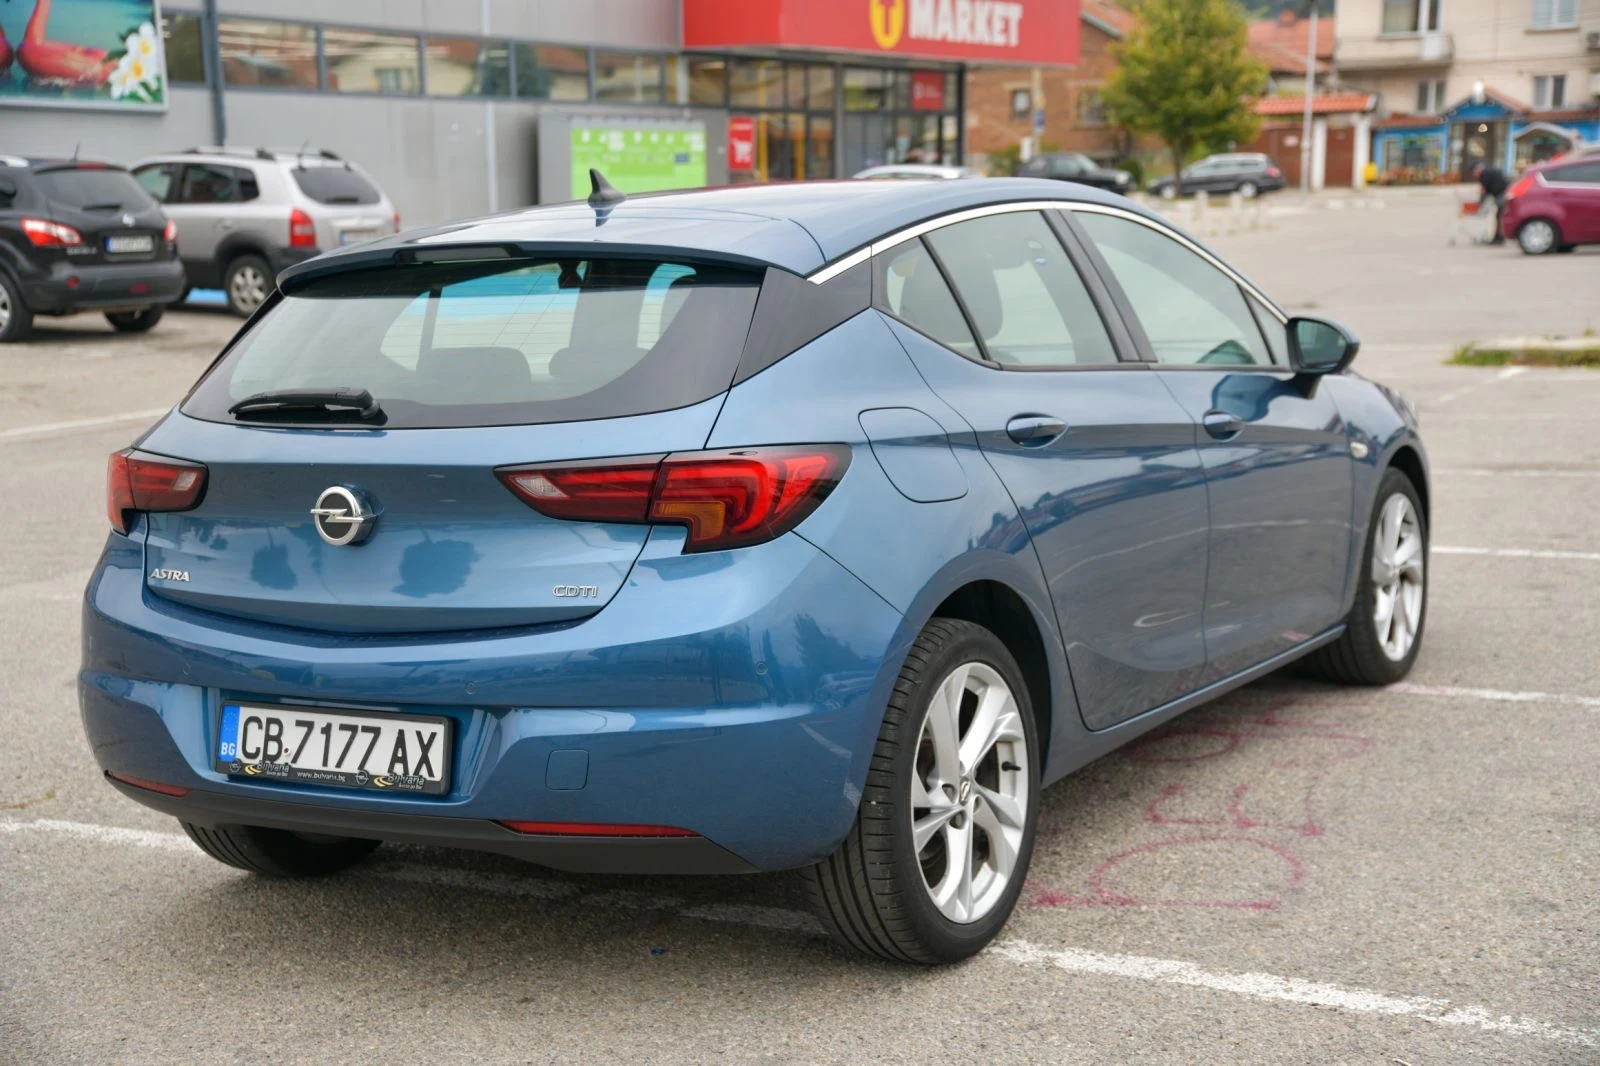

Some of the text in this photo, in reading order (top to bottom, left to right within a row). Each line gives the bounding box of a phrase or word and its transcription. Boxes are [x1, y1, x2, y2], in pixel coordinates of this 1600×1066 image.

[909, 0, 1023, 47] MARKET
[151, 568, 190, 582] ASTRA
[553, 585, 598, 598] CDTI
[221, 742, 236, 756] BG
[241, 715, 438, 778] CB 7177 AX
[387, 773, 425, 786] Bulvaria
